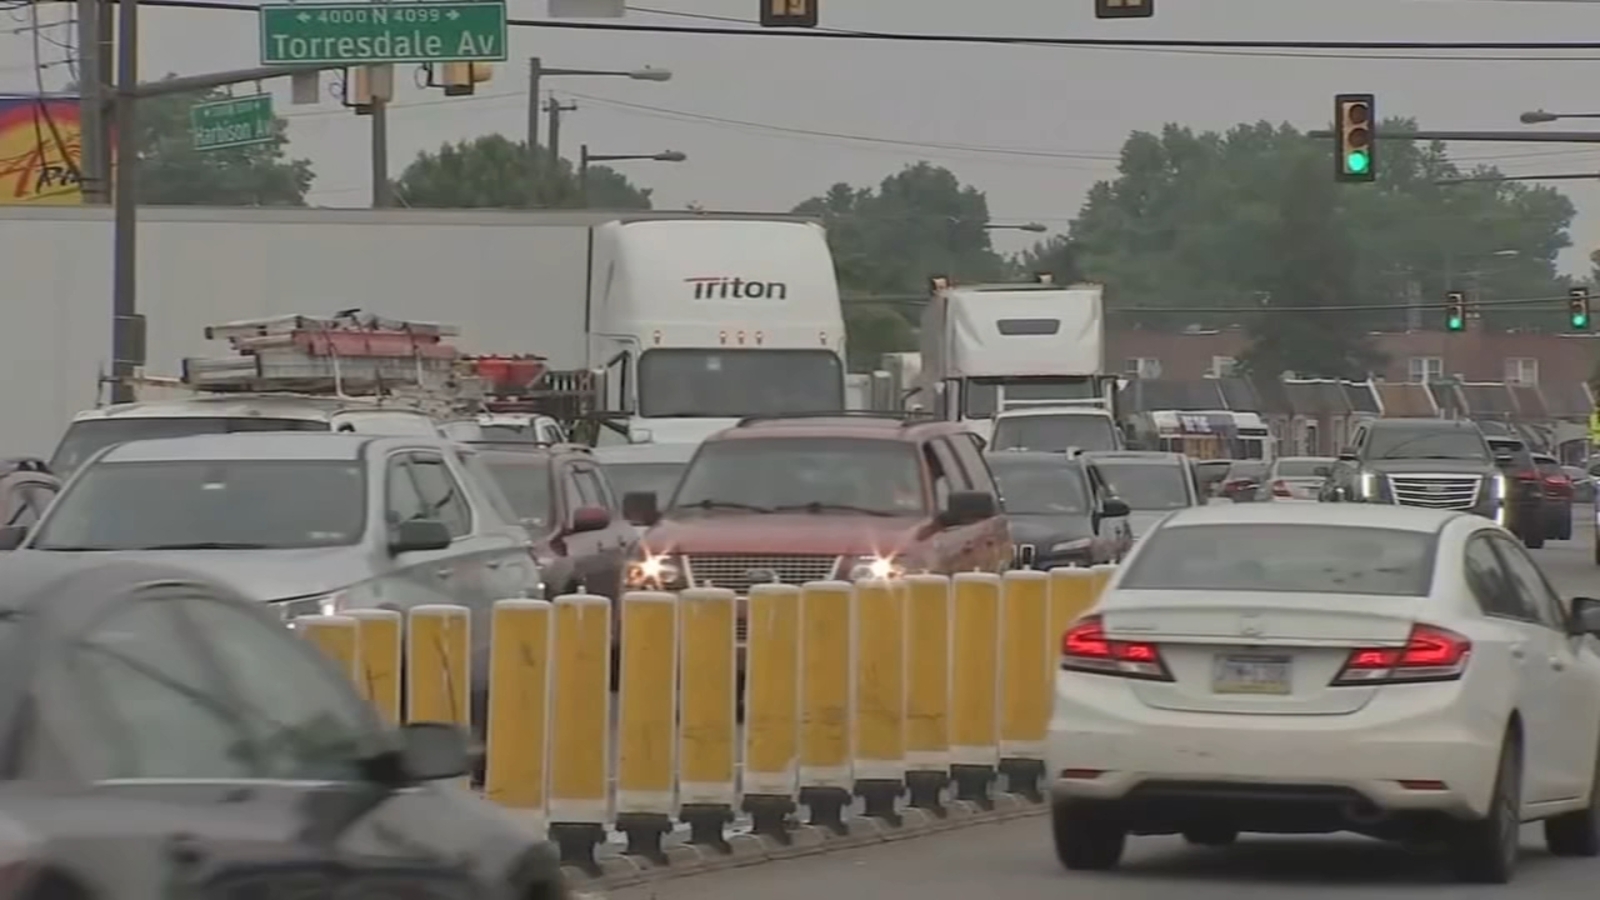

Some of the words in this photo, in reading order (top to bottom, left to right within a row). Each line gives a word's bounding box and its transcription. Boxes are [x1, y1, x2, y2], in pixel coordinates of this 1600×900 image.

[317, 9, 367, 23] 4000
[372, 8, 388, 24] N
[393, 9, 441, 22] 4099
[272, 30, 442, 58] Torresdale
[457, 30, 495, 56] Av
[683, 276, 786, 300] Triton
